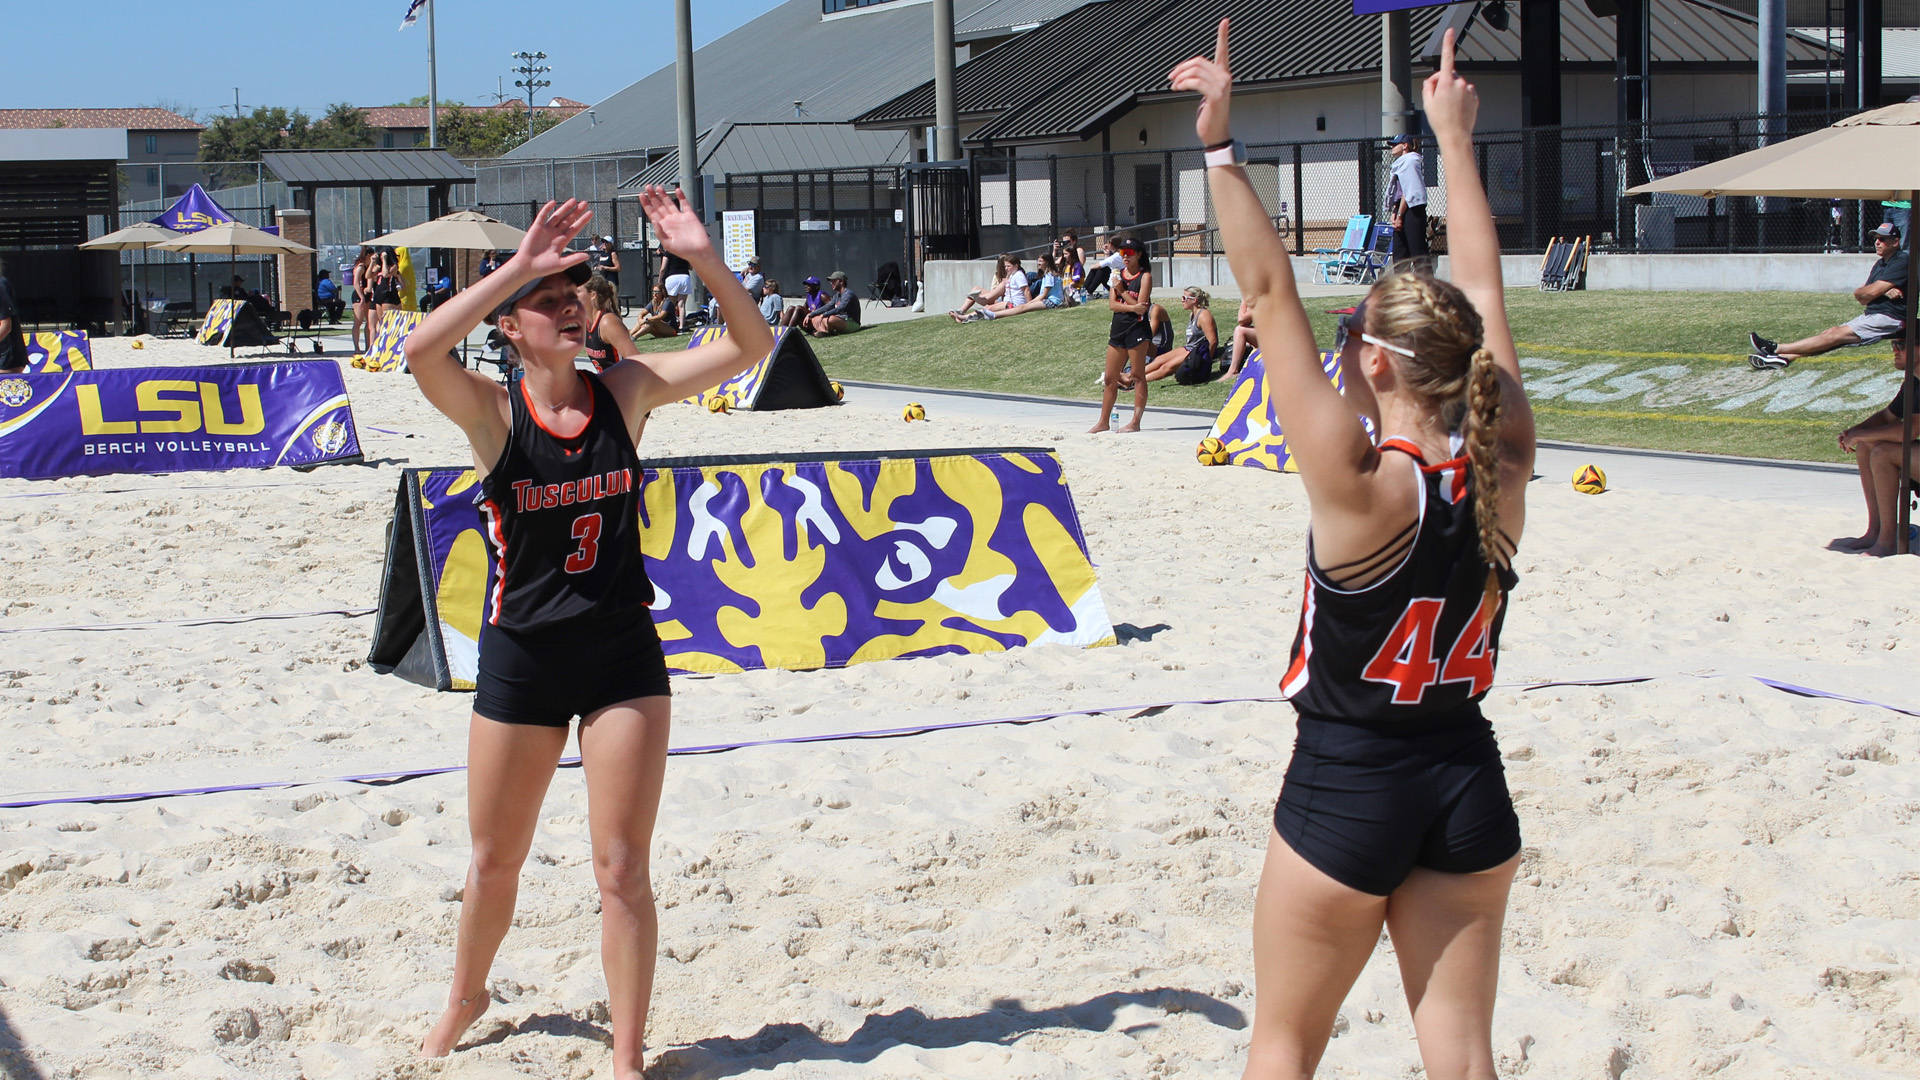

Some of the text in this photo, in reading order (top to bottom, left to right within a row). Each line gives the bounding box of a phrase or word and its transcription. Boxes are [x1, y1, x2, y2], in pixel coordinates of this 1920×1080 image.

[177, 211, 222, 226] LSU
[75, 380, 265, 436] LSU
[84, 440, 271, 455] BEACH VOLLEYBALL
[564, 512, 603, 574] 3
[1360, 590, 1502, 704] 44
